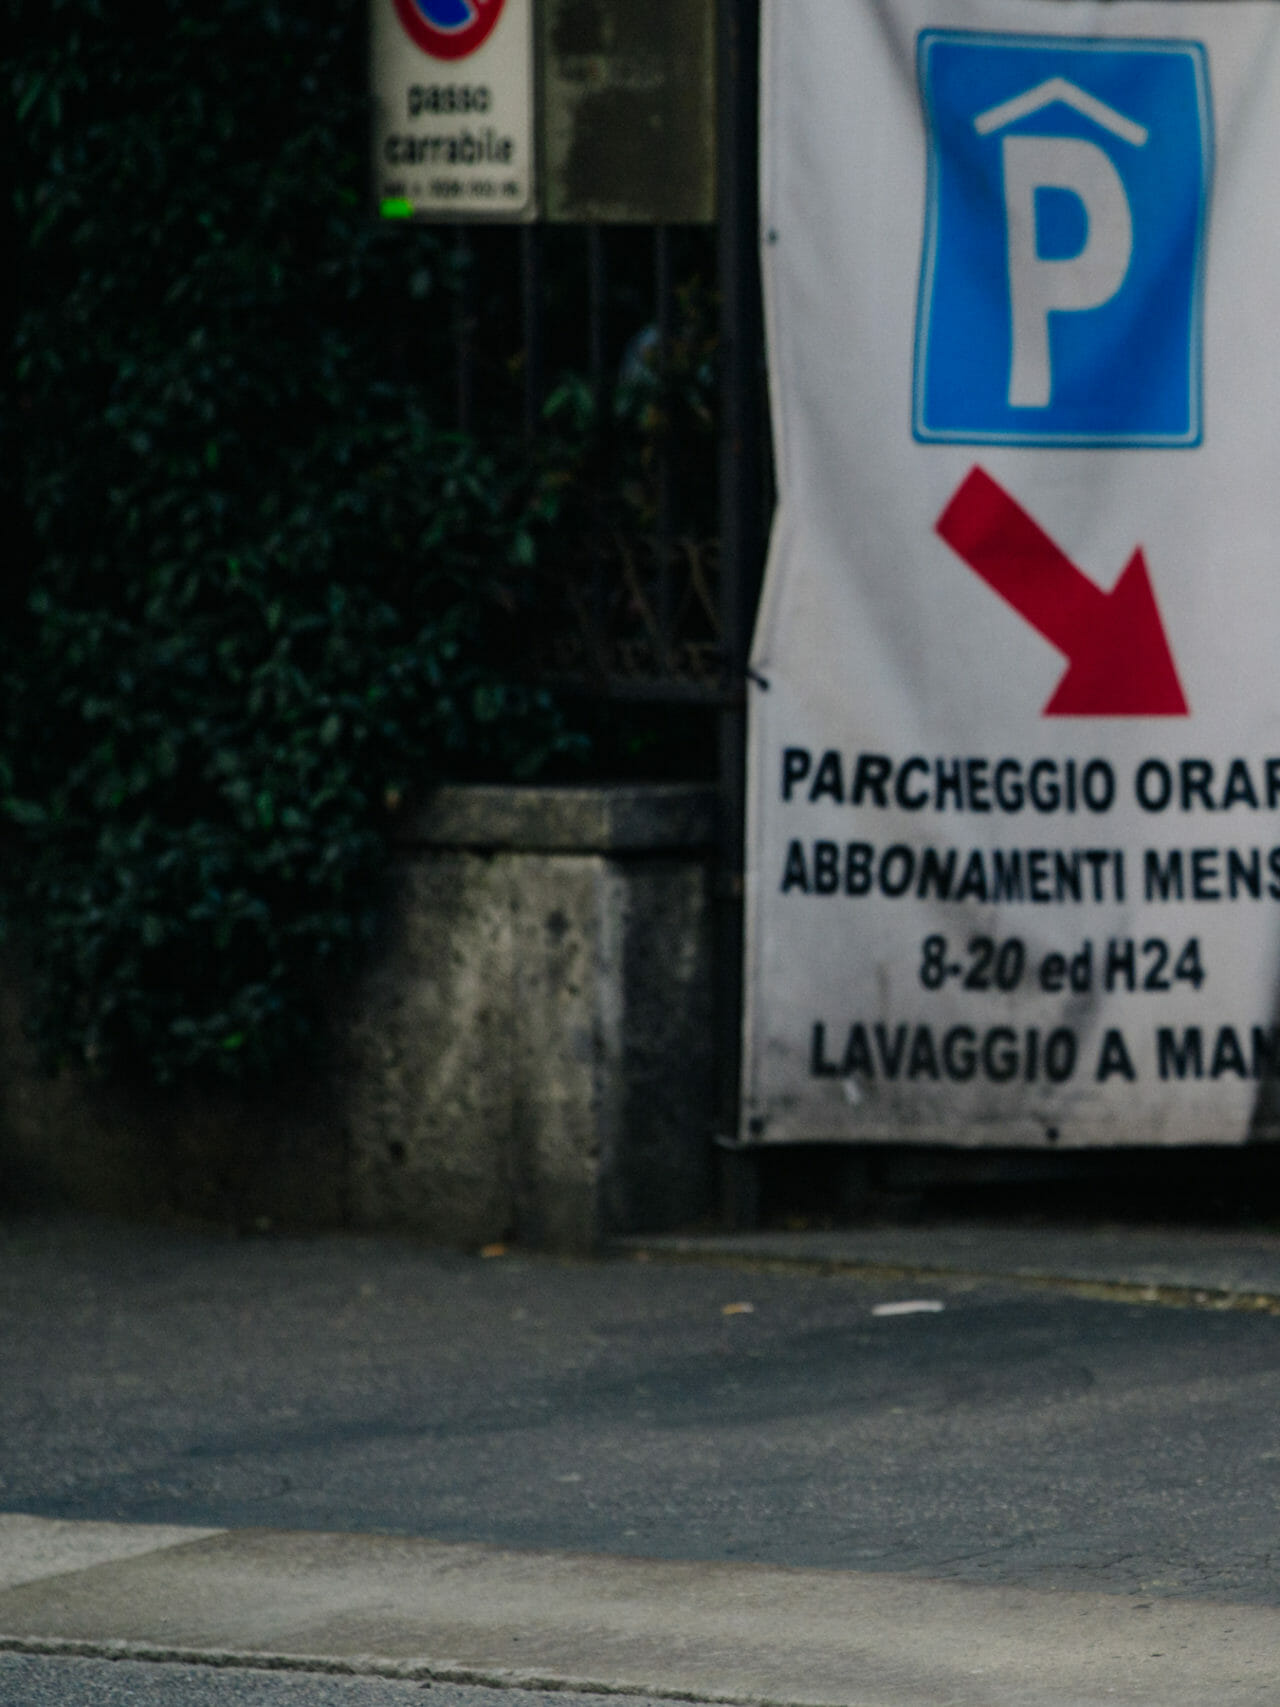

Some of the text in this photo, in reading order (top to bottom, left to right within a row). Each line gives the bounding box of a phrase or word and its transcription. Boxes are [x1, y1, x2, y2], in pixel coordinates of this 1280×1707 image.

[407, 83, 490, 116] passo
[383, 128, 512, 163] carrabile
[1003, 135, 1133, 408] P
[781, 748, 1116, 814] PARCHEGGIO
[780, 839, 1126, 902] ABBONAMENTI
[919, 935, 1205, 993] 8-20 ed H24
[811, 1021, 1077, 1083] LAVAGGIO
[1096, 1029, 1135, 1083] A
